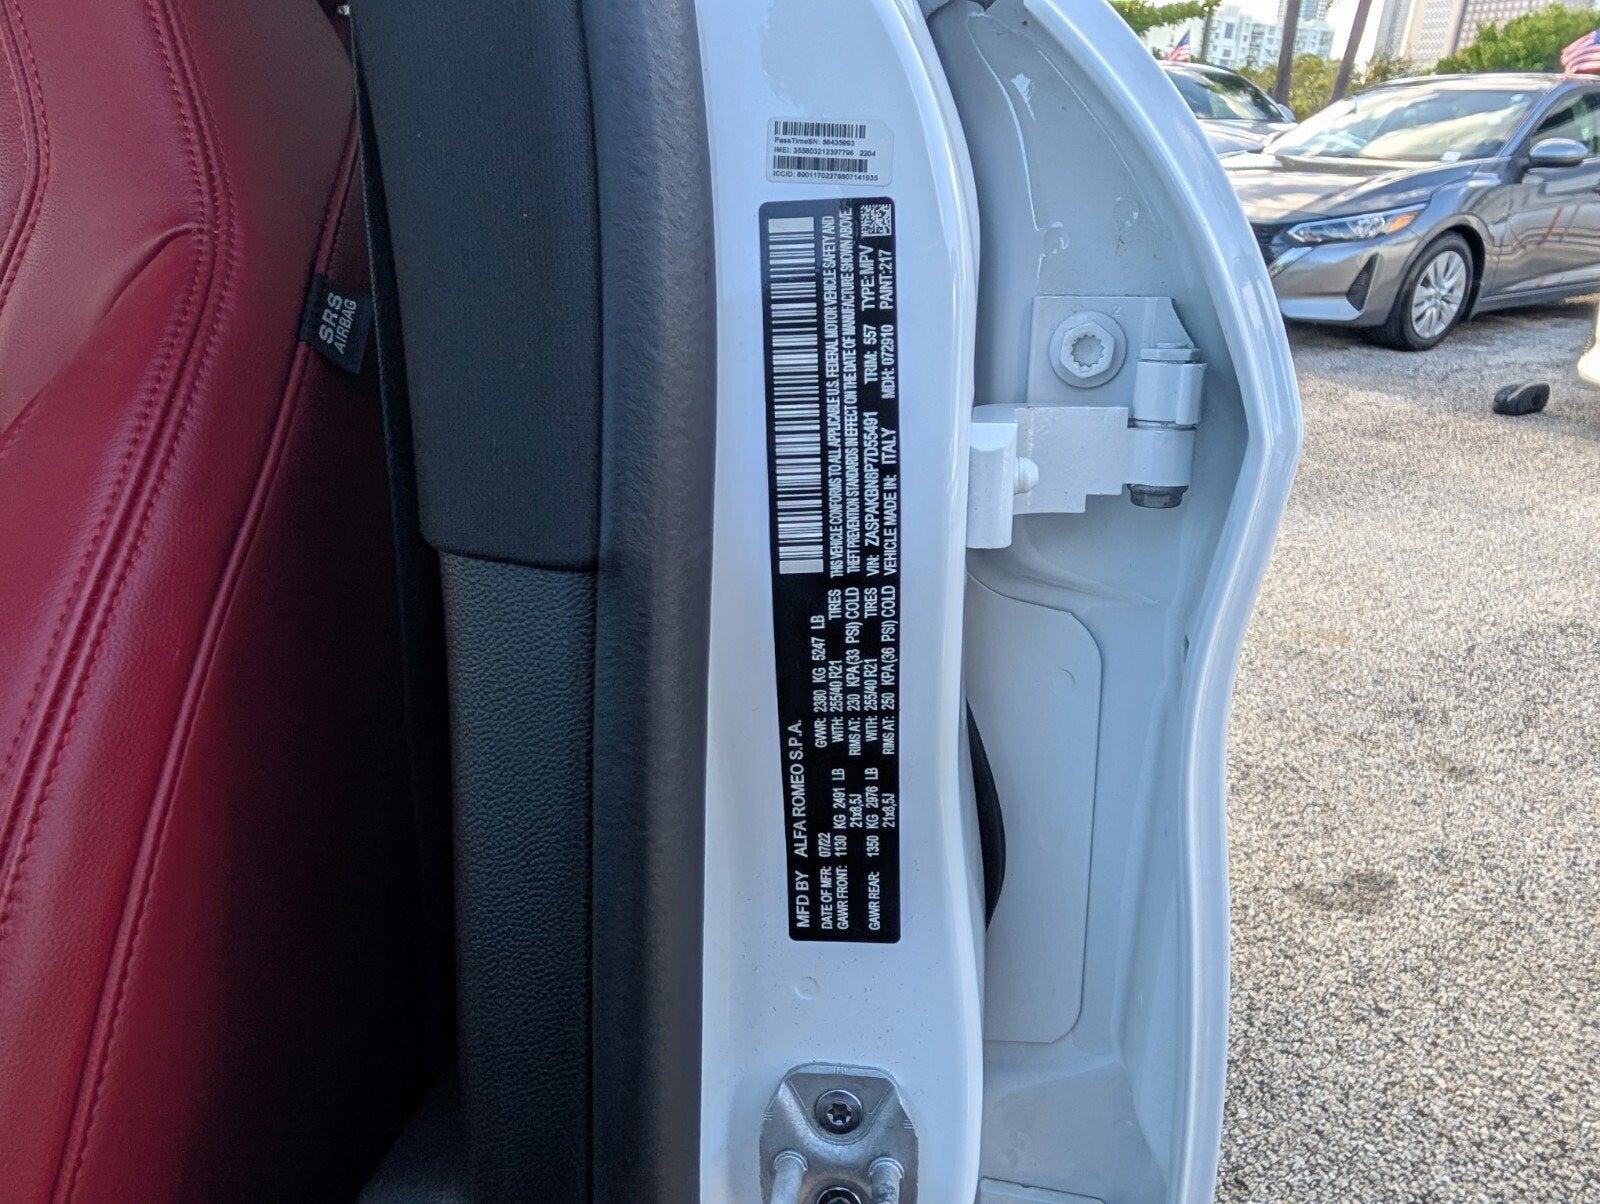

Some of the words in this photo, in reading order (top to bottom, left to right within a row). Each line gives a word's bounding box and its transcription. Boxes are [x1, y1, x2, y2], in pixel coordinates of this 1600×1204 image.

[822, 216, 835, 234] AND
[839, 208, 852, 238] ABOVE.
[822, 235, 836, 268] SAFETY
[840, 240, 854, 272] SHOWN
[823, 269, 837, 305] VEHICLE
[841, 273, 856, 335] MANUFACTURE
[318, 292, 343, 344] SRS
[334, 299, 357, 354] AIRBAG
[824, 307, 838, 338] MOTOR
[842, 337, 856, 348] OF
[863, 324, 877, 345] 557
[880, 325, 894, 365] 072910
[825, 339, 839, 377] FEDERAL
[843, 349, 856, 372] DATE
[864, 351, 878, 384] TRIM:
[826, 379, 840, 395] U.S.
[843, 373, 857, 390] THE
[882, 368, 895, 398] MDH:
[844, 391, 857, 404] ON
[826, 397, 841, 447] APPLICABLE
[844, 405, 858, 436] EFFECT
[845, 438, 858, 446] IN
[881, 427, 896, 464] ITALY
[828, 448, 841, 463] ALL
[828, 465, 842, 476] TO
[845, 448, 859, 496] STANDARDS
[864, 411, 879, 546] ZASPAKBN8P7D55491
[883, 475, 896, 489] IN:
[829, 478, 842, 524] CONFORMS
[883, 492, 897, 525] MADE
[846, 498, 860, 548] PREVENTION
[829, 525, 843, 559] VEHICLE
[883, 528, 897, 575] VEHICLE
[830, 560, 844, 578] THIS
[847, 549, 860, 573] THEFT
[866, 555, 880, 576] VIN:
[828, 589, 842, 620] TIRES
[845, 587, 860, 619] COLD
[864, 588, 877, 618] TIRES
[881, 586, 895, 617] COLD
[811, 615, 825, 629] LB
[845, 622, 862, 643] PSI)
[881, 620, 898, 642] PSI)
[811, 637, 826, 660] 5247
[812, 668, 826, 683] KG
[829, 660, 842, 678] R21
[864, 659, 877, 677] R21
[813, 690, 827, 712] 2380
[830, 681, 843, 712] 255/40
[847, 694, 860, 711] 230
[864, 680, 878, 711] 255/40
[881, 693, 895, 710] 250
[814, 718, 827, 748] GVWR:
[831, 717, 844, 742] WITH:
[848, 718, 861, 732] AT:
[865, 716, 878, 741] WITH:
[882, 716, 894, 731] AT:
[788, 720, 803, 760] S.P.A.
[849, 734, 861, 756] RIMS
[882, 733, 894, 754] RIMS
[832, 768, 845, 780] LB
[865, 768, 878, 780] LB
[790, 764, 806, 816] ROMEO
[833, 787, 846, 808] 2491
[865, 786, 879, 808] 2976
[833, 815, 846, 829] KG
[850, 794, 863, 827] 21x8,5J
[866, 815, 879, 829] KG
[882, 793, 896, 827] 21x8,5J
[793, 821, 808, 857] ALFA
[819, 833, 831, 857] 07/22
[834, 835, 847, 857] 1130
[867, 835, 879, 857] 1350
[795, 870, 809, 891] BY
[820, 866, 832, 888] MFR:
[835, 865, 848, 899] FRONT:
[868, 872, 880, 899] REAR:
[821, 890, 832, 901] OF
[796, 895, 810, 927] MFD
[821, 904, 833, 929] DATE
[836, 900, 849, 929] GAWR
[869, 901, 880, 930] GAWR
